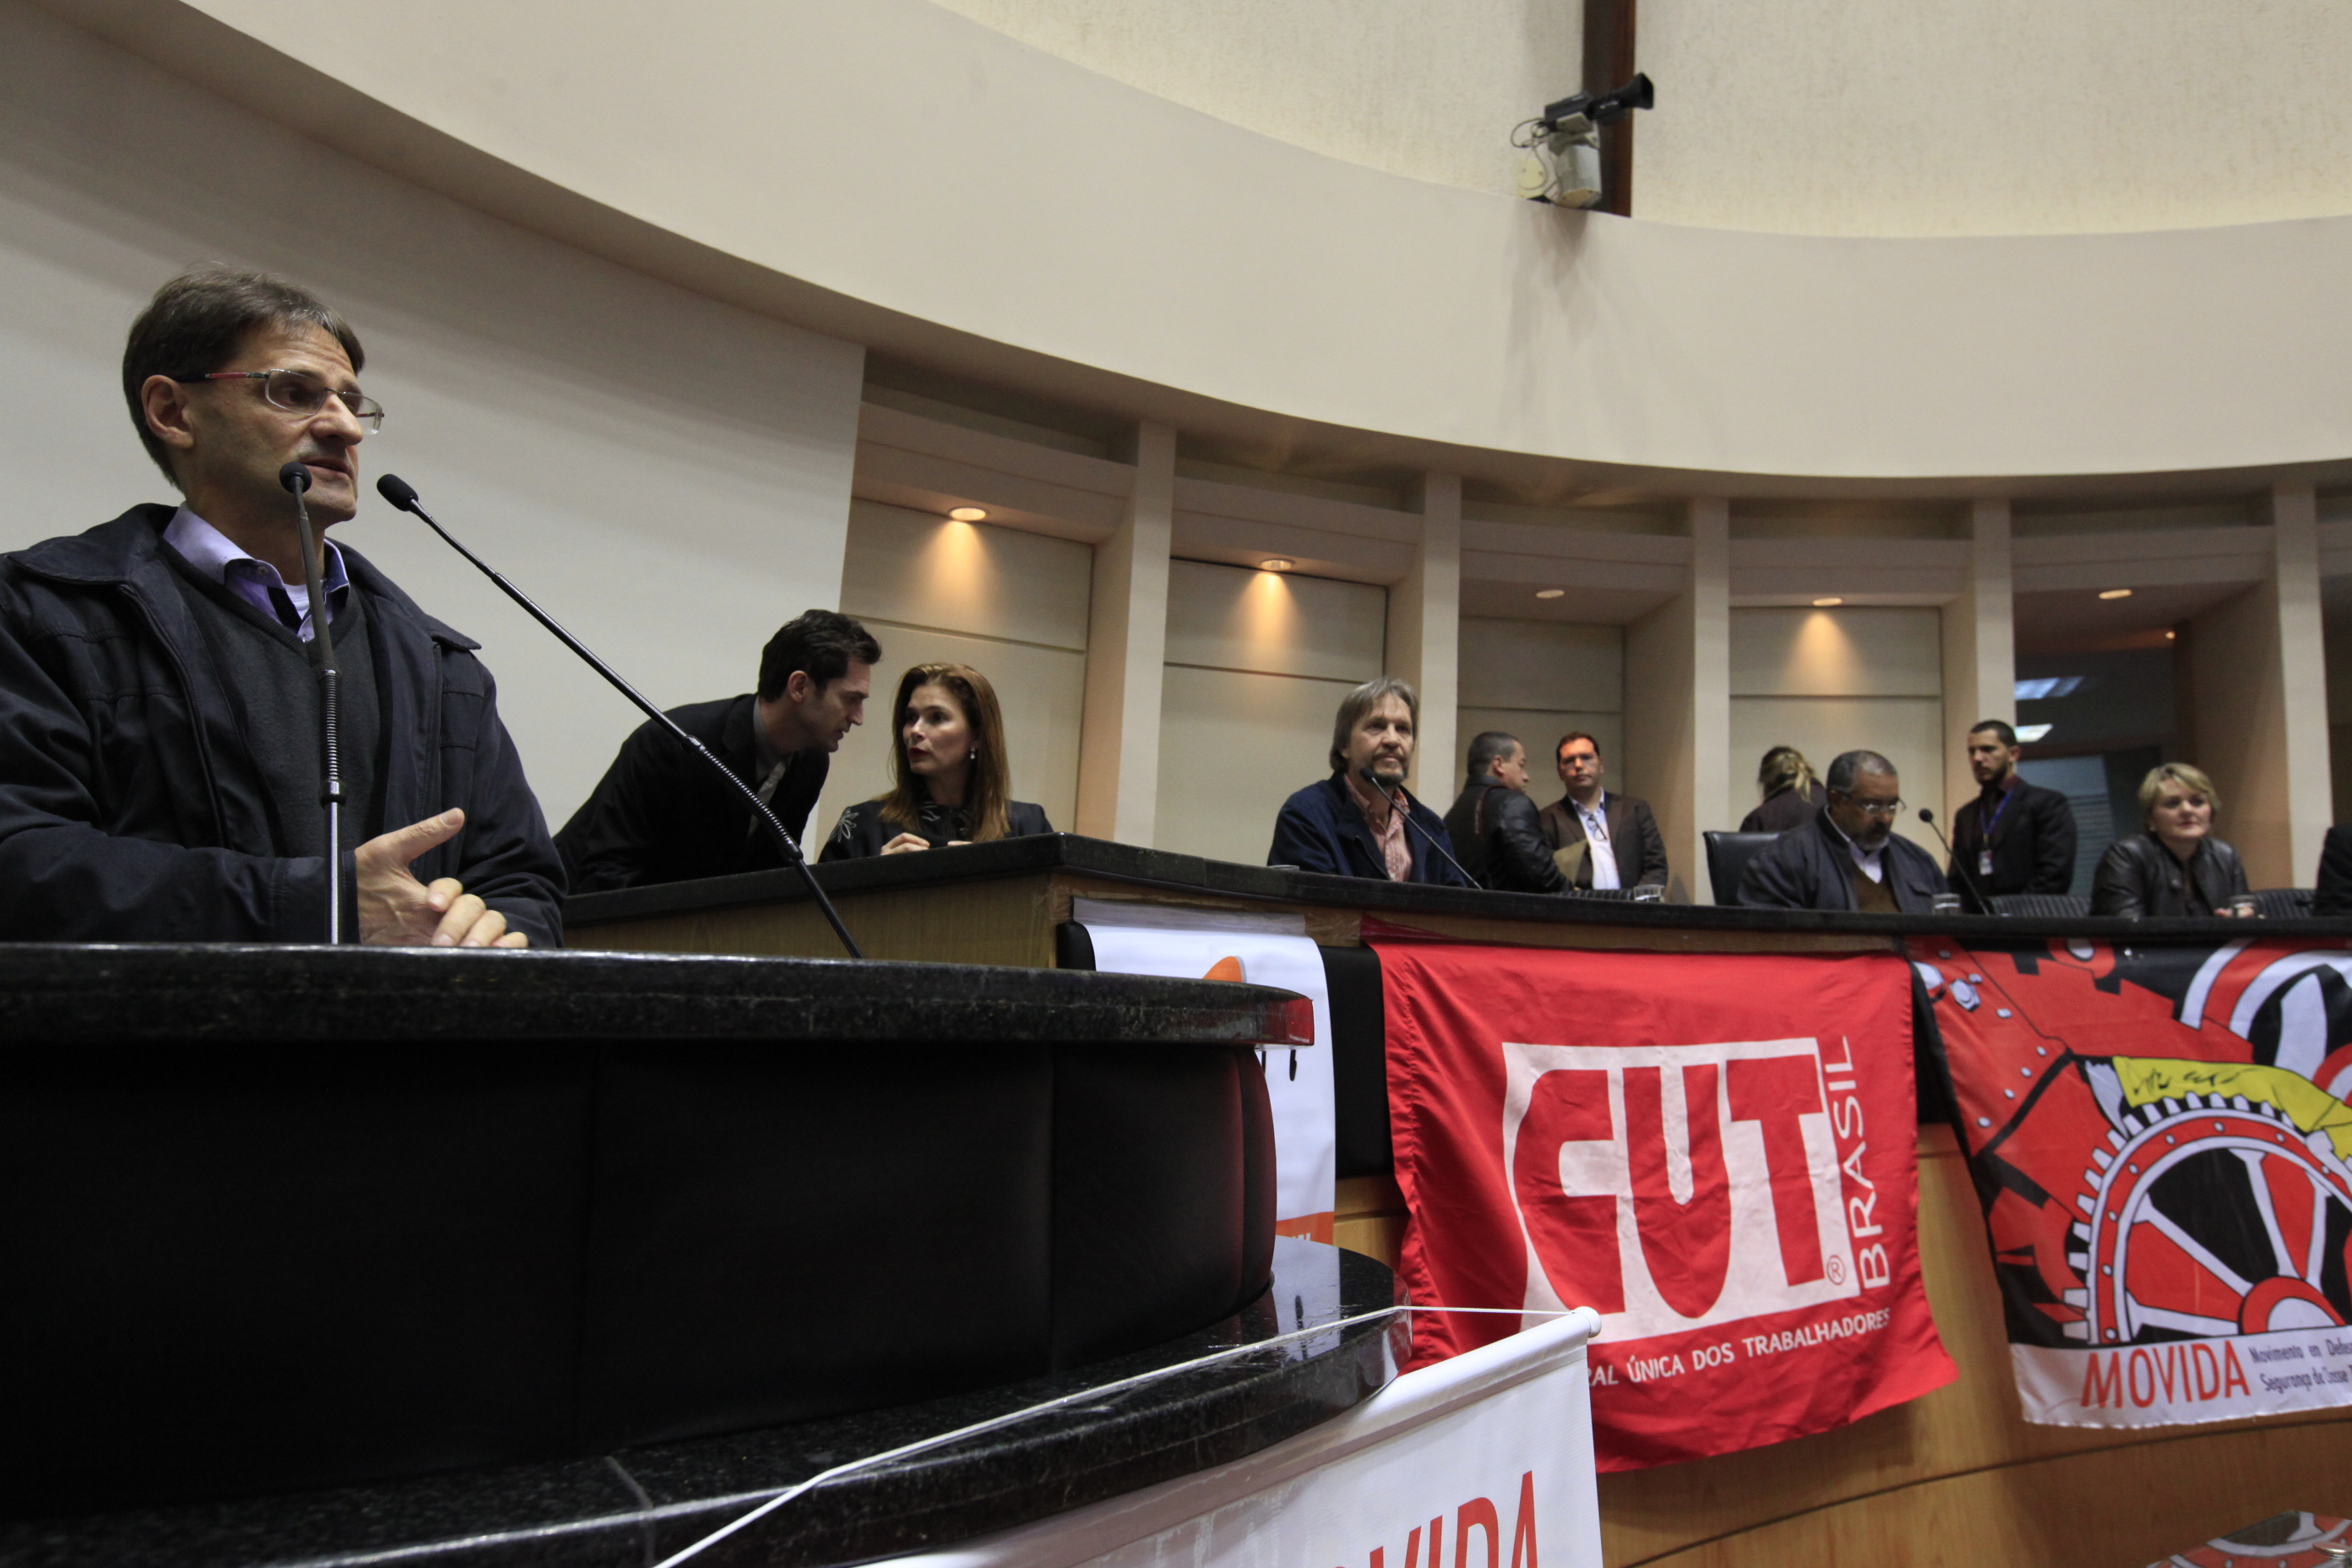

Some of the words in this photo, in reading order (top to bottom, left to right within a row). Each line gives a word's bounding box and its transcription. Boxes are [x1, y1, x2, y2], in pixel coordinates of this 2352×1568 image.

[1512, 1054, 1827, 1318] CUT
[1825, 1036, 1890, 1289] BRASIL
[1626, 1355, 1685, 1382] ÚNICA
[1691, 1342, 1734, 1371] DOS
[1741, 1308, 1891, 1358] TRABALHADORES
[2081, 1340, 2251, 1408] MOVIDA
[2248, 1345, 2305, 1364] Movimento
